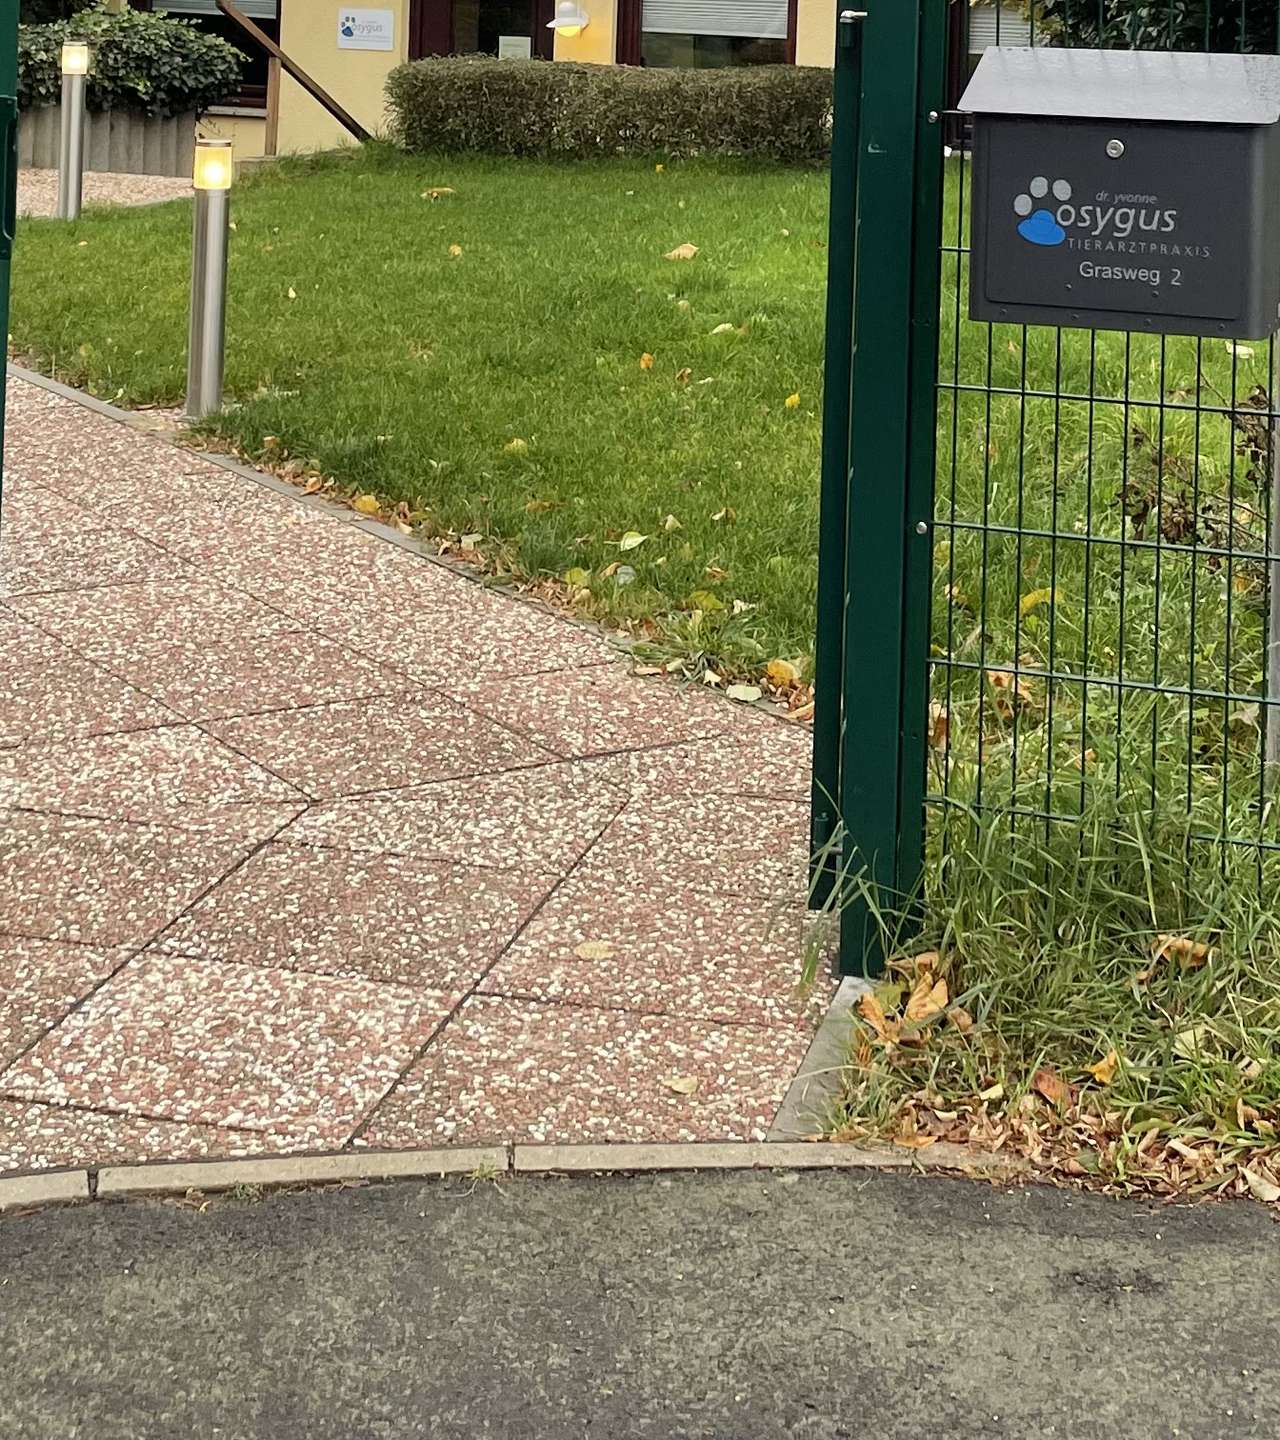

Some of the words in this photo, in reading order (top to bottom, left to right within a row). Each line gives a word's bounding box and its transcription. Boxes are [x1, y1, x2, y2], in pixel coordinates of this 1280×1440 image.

[1095, 190, 1110, 202] dr.
[1114, 192, 1158, 205] yvonne
[1056, 204, 1177, 238] osygus
[1067, 237, 1211, 258] TIERARZTPRAXIS
[1079, 261, 1161, 286] Grasweg
[1170, 268, 1182, 286] 2
